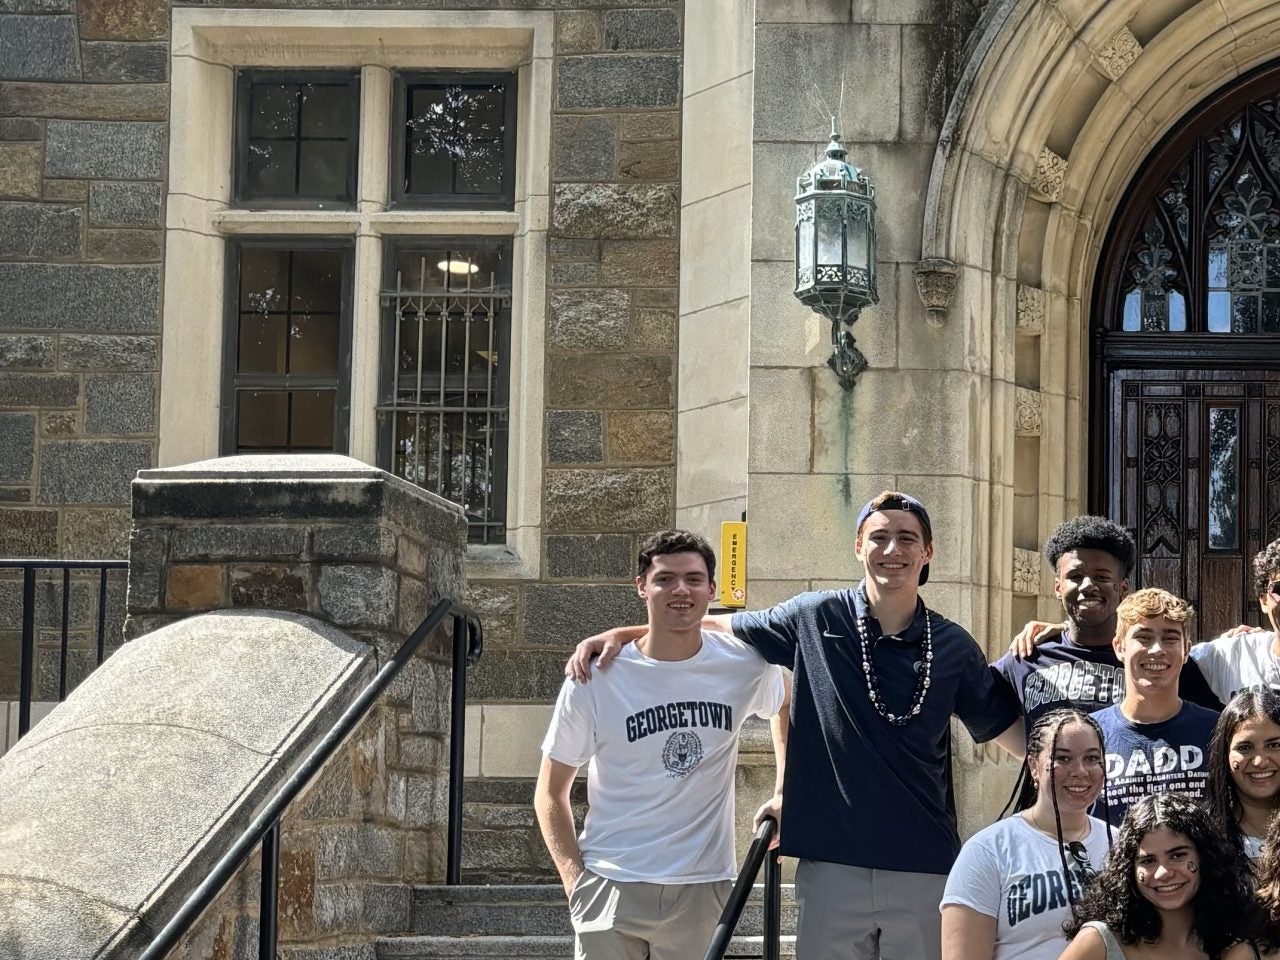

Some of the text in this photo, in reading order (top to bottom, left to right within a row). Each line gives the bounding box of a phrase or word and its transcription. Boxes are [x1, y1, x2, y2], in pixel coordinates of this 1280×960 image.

[1024, 660, 1126, 714] GEORGETO
[625, 701, 733, 743] GEORGETOWN
[1105, 745, 1203, 779] DADD
[1129, 784, 1144, 794] the
[1169, 781, 1186, 790] one
[1189, 779, 1205, 789] and
